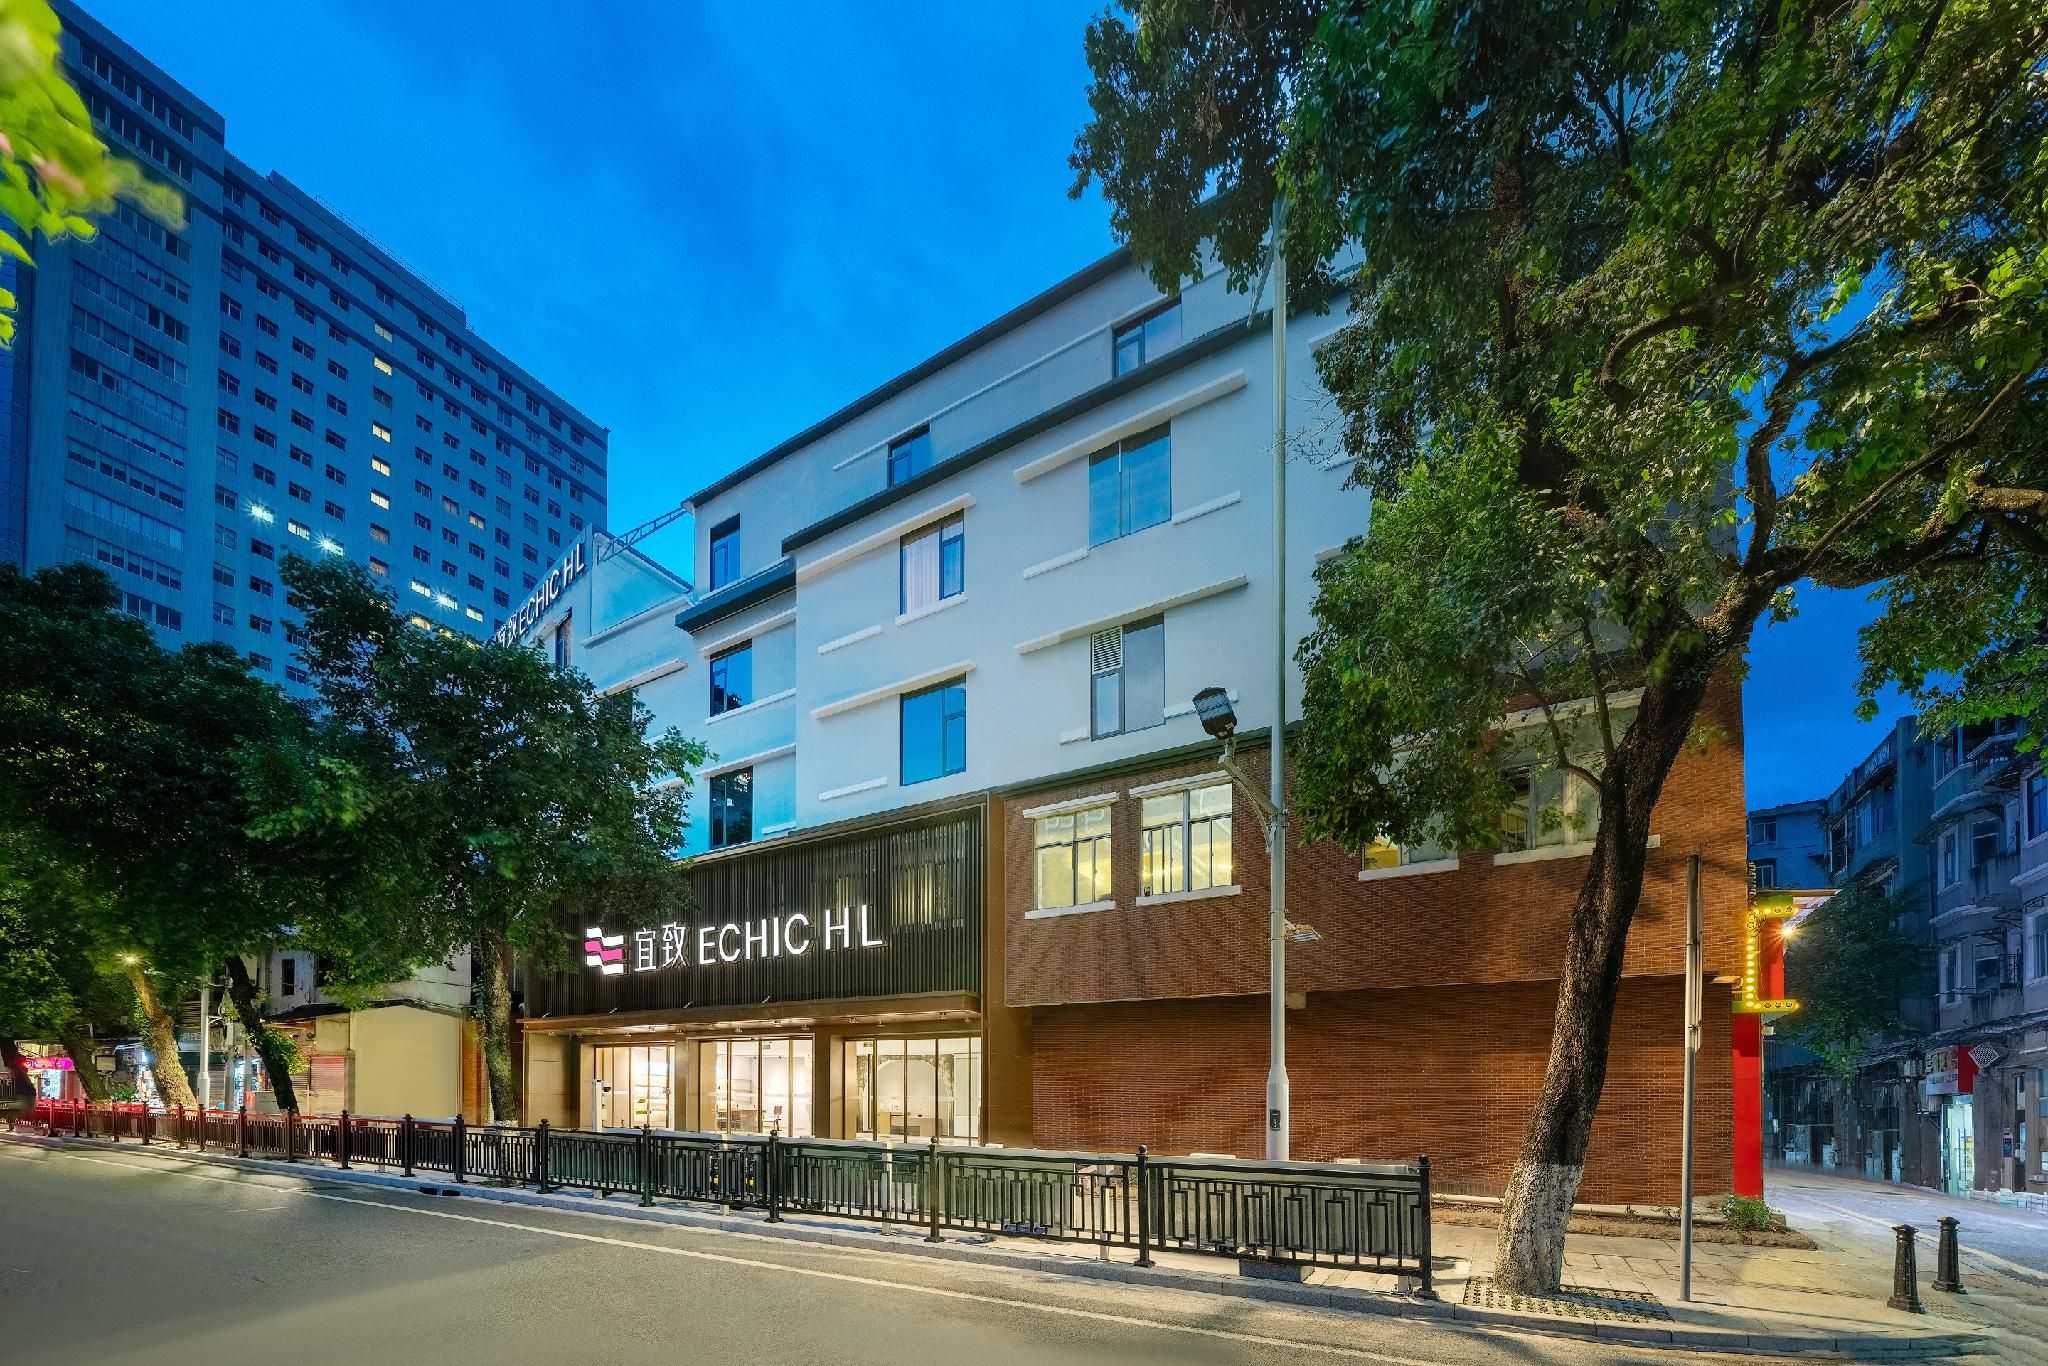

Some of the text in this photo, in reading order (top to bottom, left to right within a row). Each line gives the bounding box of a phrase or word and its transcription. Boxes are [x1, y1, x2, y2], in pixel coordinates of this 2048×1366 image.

[519, 569, 560, 634] ECHIC
[563, 543, 585, 587] HL
[635, 904, 882, 971] 宜致 ECHIC HL
